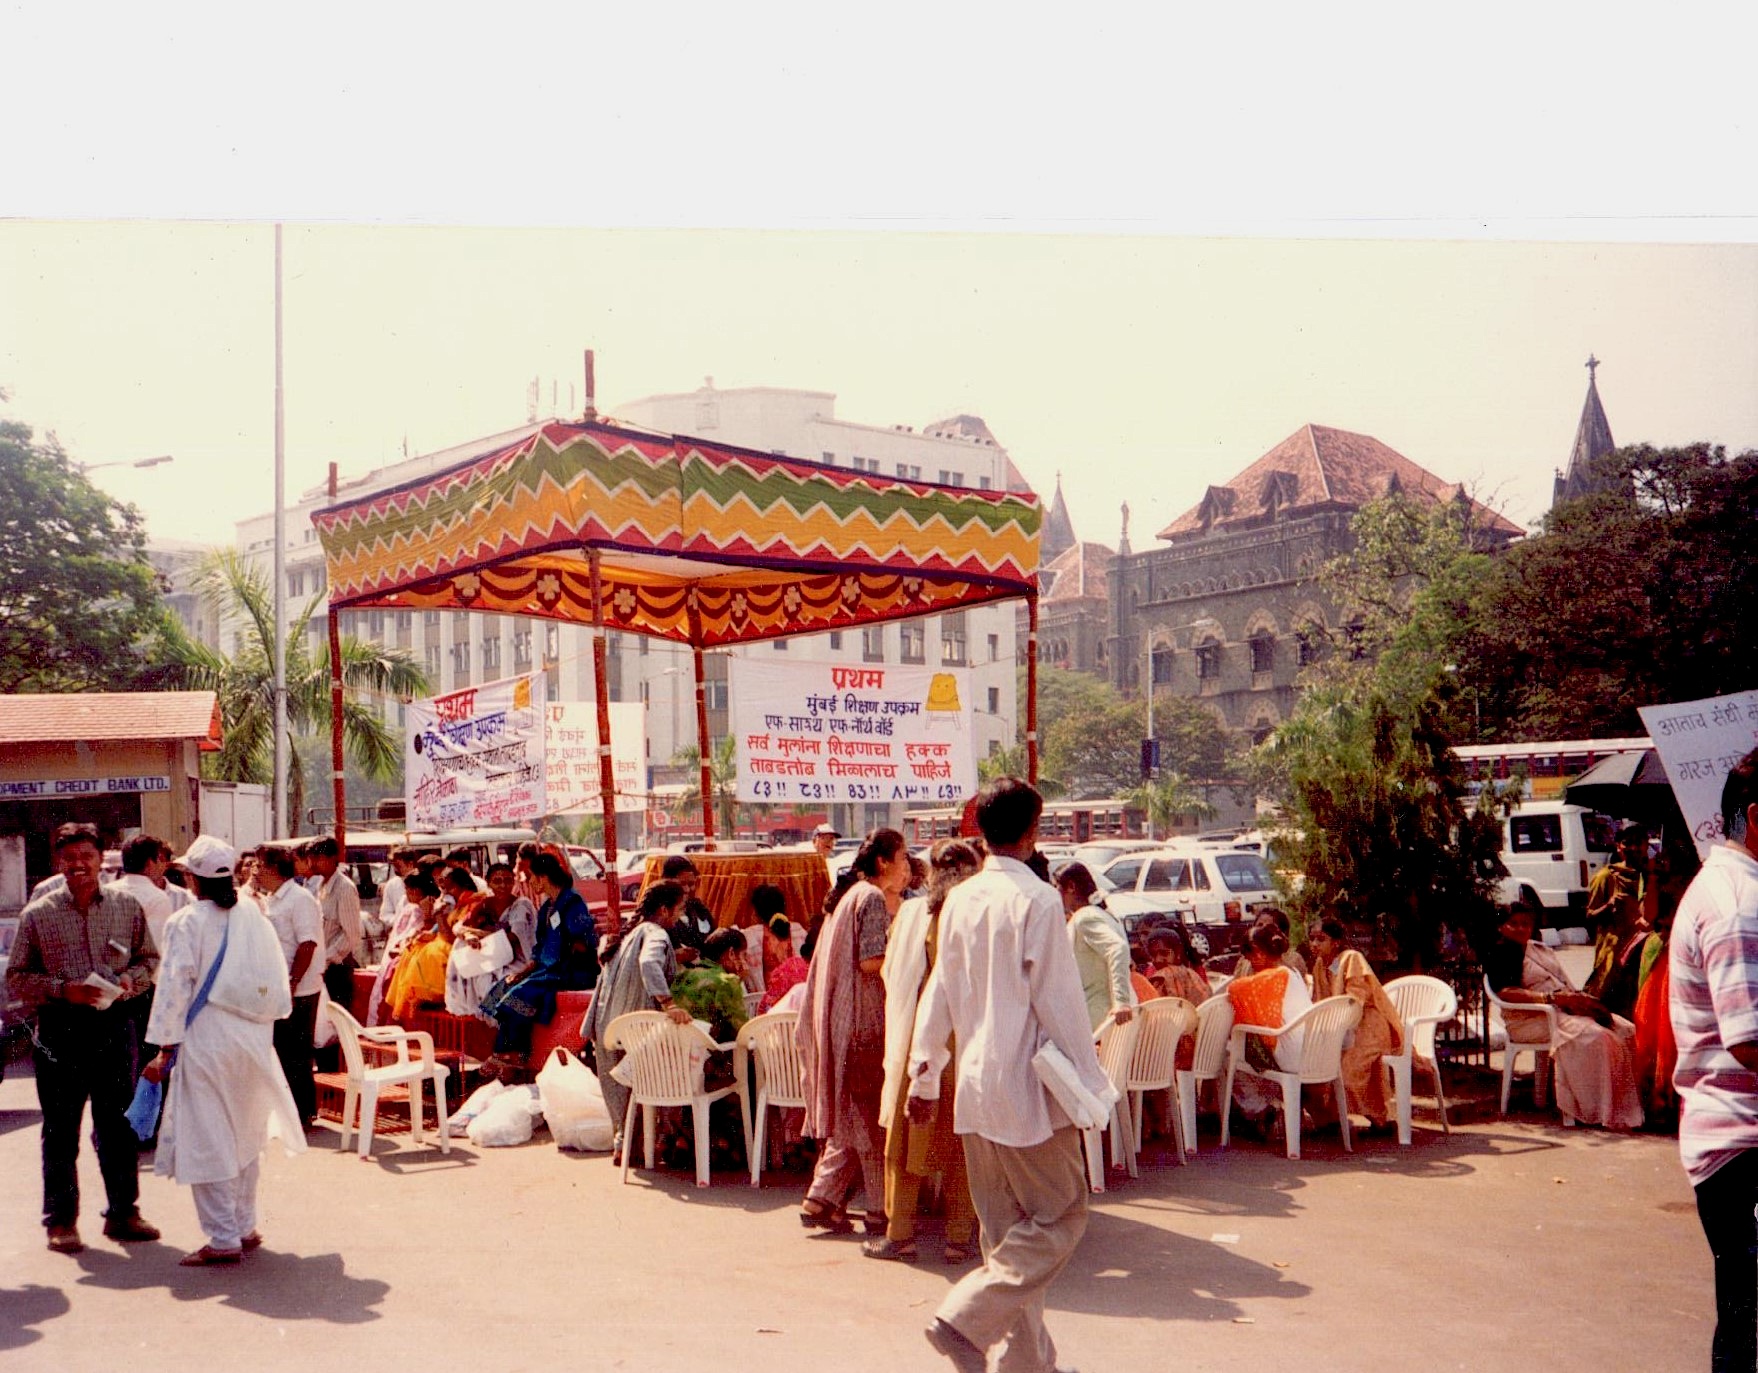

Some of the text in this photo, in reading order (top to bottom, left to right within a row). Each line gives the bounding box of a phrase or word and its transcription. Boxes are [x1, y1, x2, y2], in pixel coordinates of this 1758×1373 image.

[831, 667, 885, 692] प्रथम
[806, 693, 922, 717] मुंबई शिक्षण उपक्रम
[1657, 711, 1707, 737] आताच
[747, 735, 952, 760] सर्व मुलांना शिक्षणाचा हक्क
[750, 757, 952, 780] ताबडतोब मिळालाच पाहिजे
[1675, 756, 1717, 780] गरज
[55, 779, 100, 793] CREDIT
[107, 778, 140, 791] BANK
[143, 777, 169, 790] LTD.
